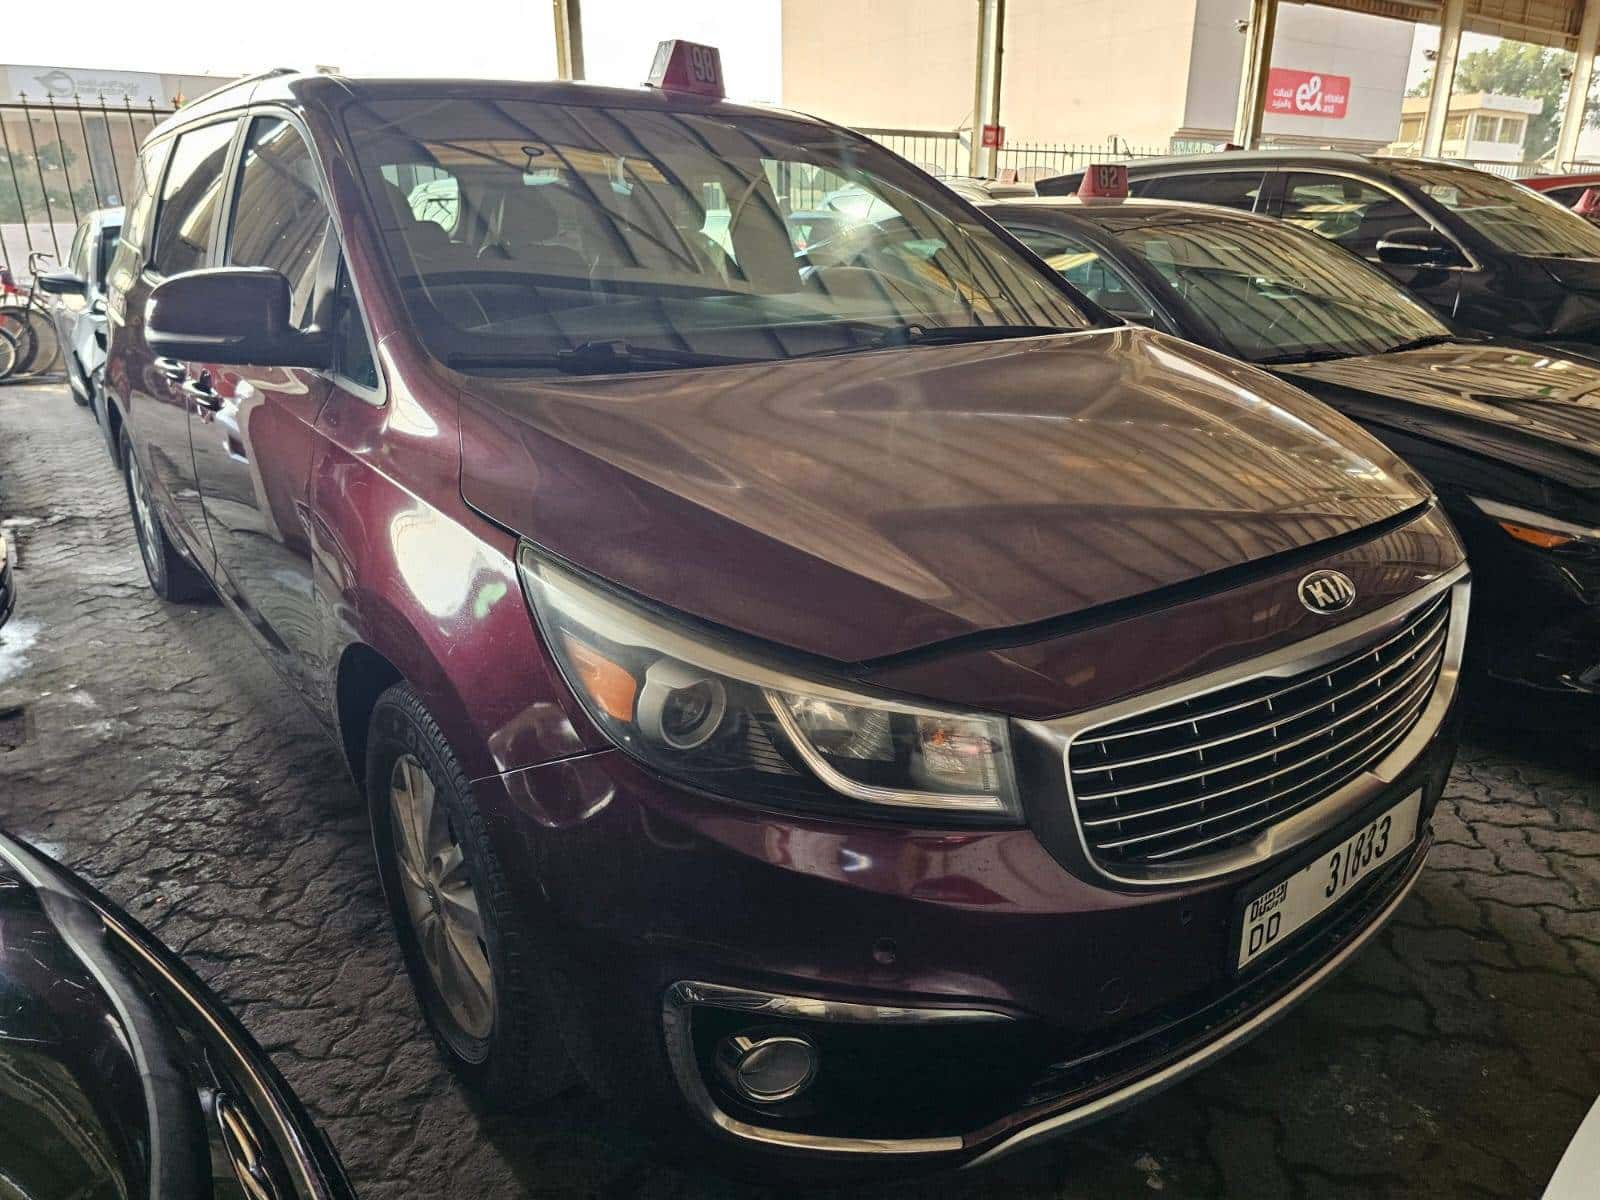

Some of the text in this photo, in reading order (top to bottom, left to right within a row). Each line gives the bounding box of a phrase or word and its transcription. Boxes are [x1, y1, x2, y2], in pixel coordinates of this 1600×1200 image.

[1305, 575, 1353, 607] KIA
[1325, 815, 1392, 898] 31833
[1248, 911, 1281, 956] DD
